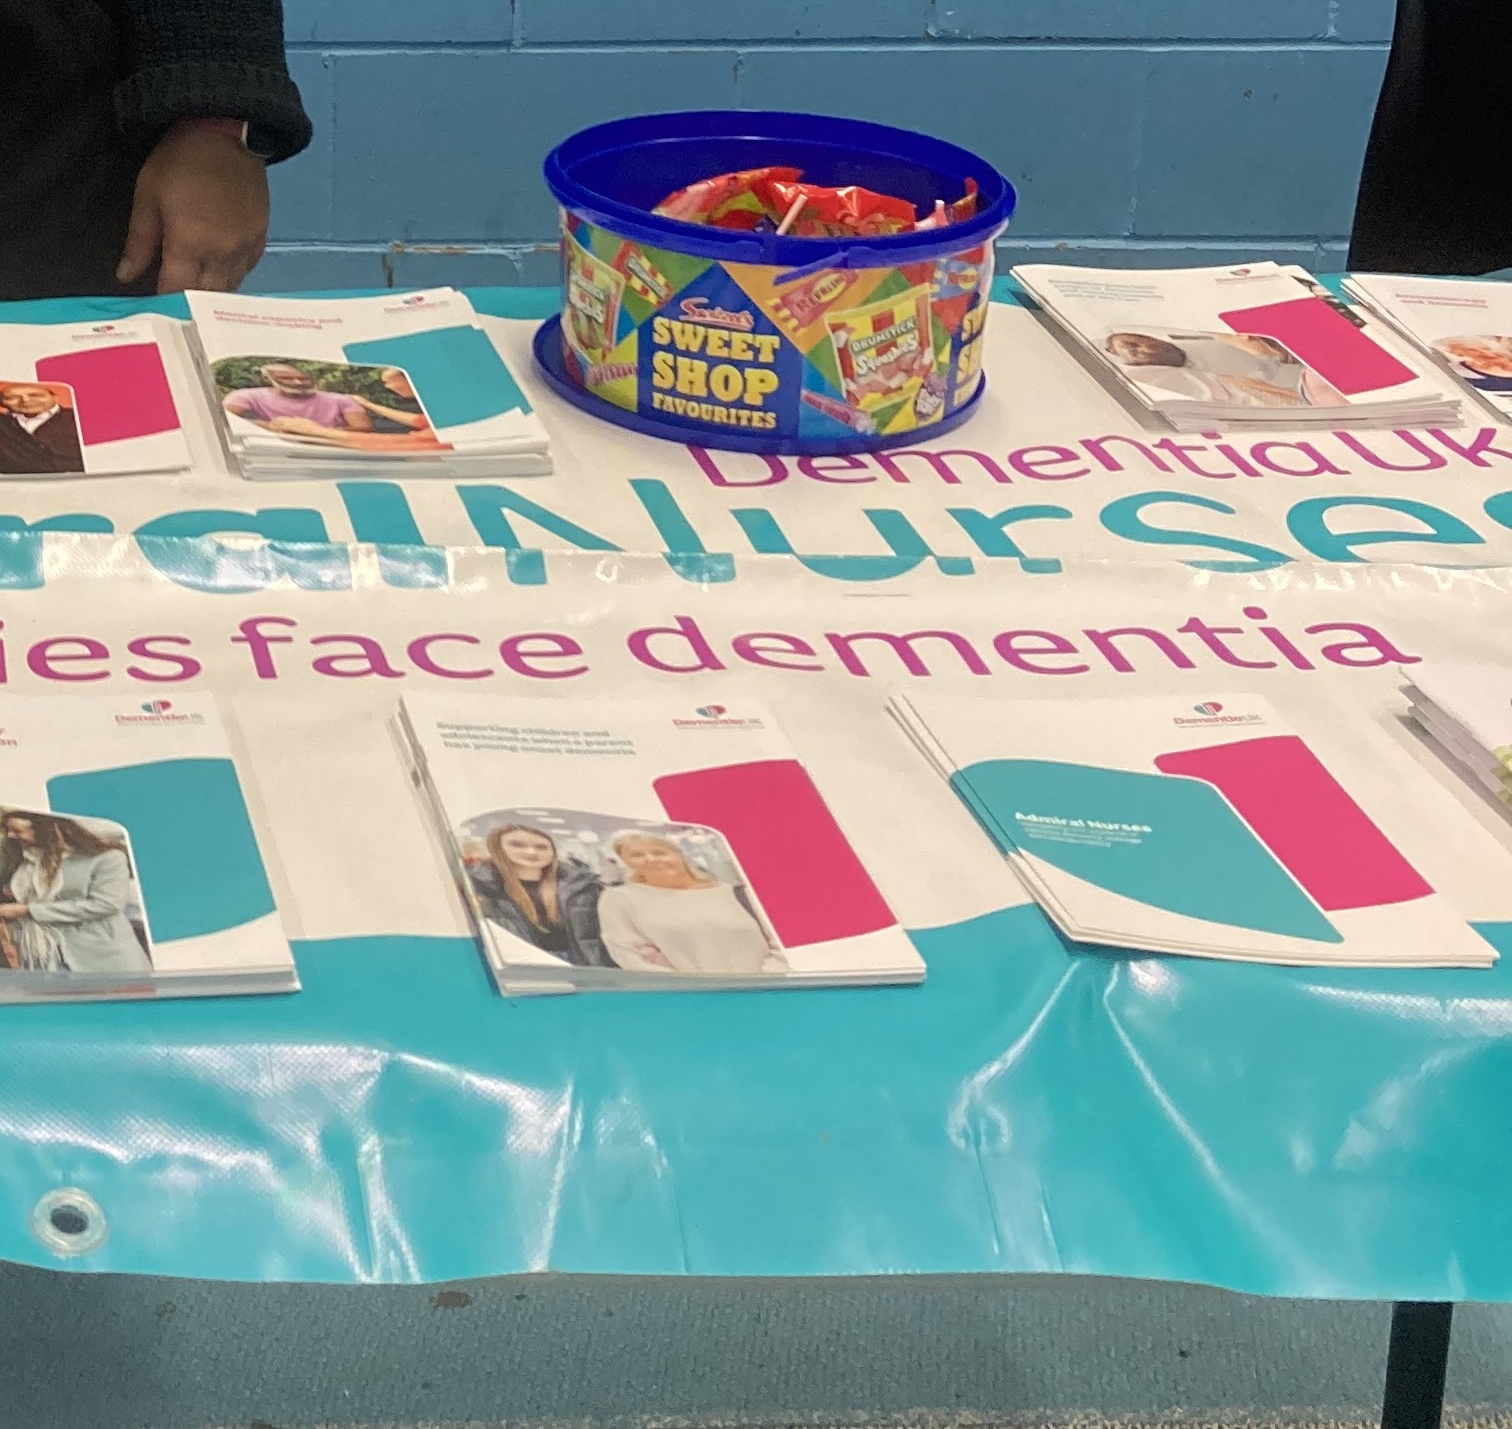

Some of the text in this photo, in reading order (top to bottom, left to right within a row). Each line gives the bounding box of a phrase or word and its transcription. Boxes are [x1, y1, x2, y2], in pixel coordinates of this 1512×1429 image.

[652, 316, 781, 363] SWEET
[851, 318, 916, 353] DRUMSTICK
[652, 350, 780, 406] SHOP
[652, 391, 778, 429] FAVOURITES
[231, 615, 589, 680] face
[626, 606, 1423, 679] dementia
[1015, 811, 1153, 833] Admiral Nurses
